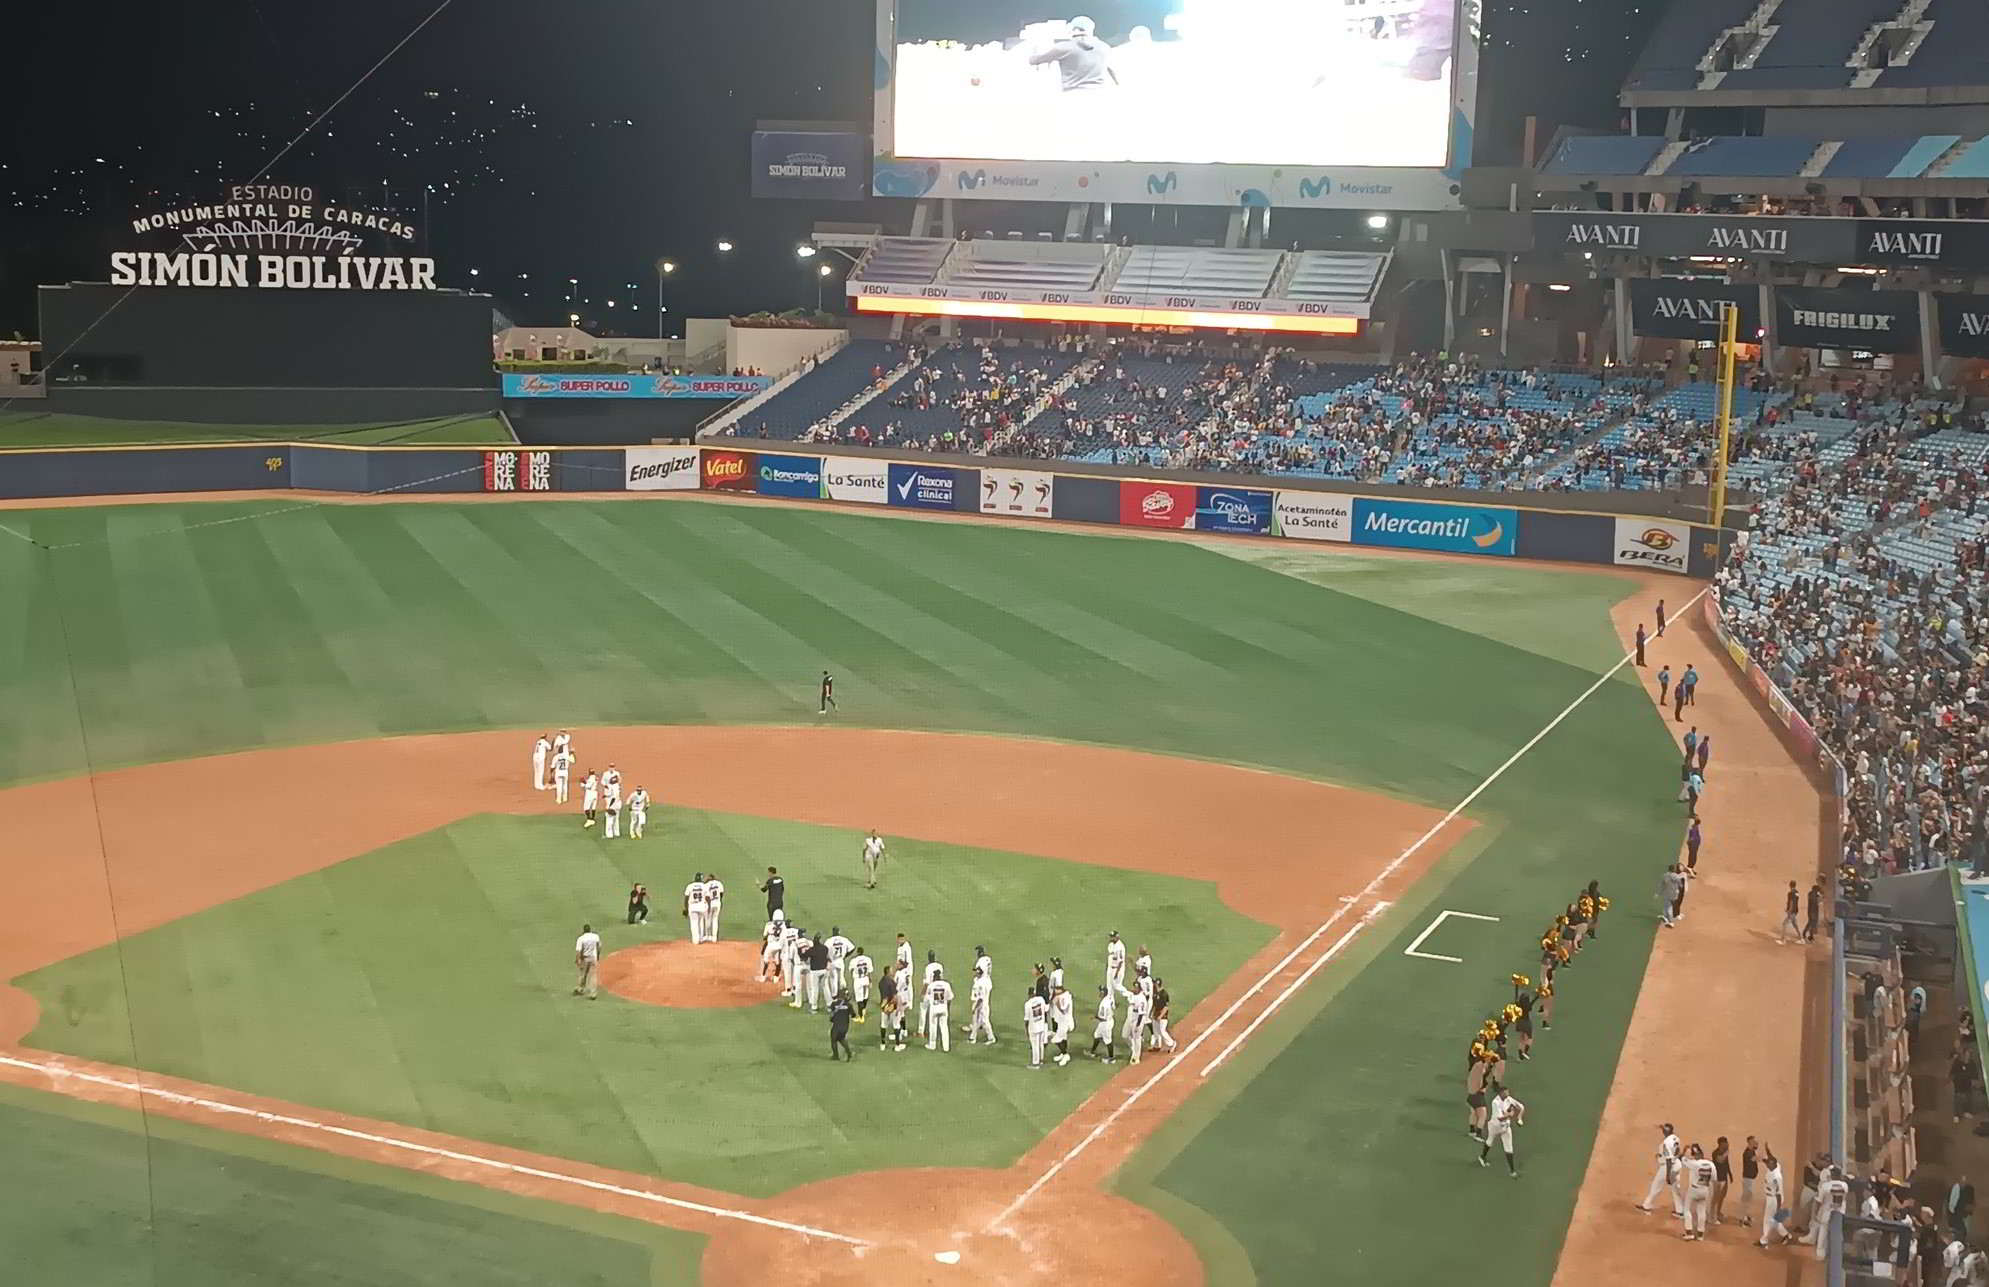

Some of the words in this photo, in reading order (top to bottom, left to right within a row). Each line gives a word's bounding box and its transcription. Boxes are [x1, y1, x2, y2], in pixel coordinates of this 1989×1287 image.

[801, 163, 846, 177] BOLÍVAR
[231, 185, 313, 201] ESTADIO
[1340, 183, 1393, 194] Movistar
[132, 203, 278, 234] MONUMENTAL
[287, 204, 313, 219] DE
[323, 207, 417, 240] CARACAS
[1565, 224, 1640, 245] AVANTI
[1706, 227, 1788, 249] AVANTI
[1868, 232, 1942, 254] AVANTI
[110, 243, 249, 287] SIMÓN
[257, 247, 437, 290] BOLÍVAR
[1793, 310, 1890, 330] FRIGILUX
[560, 381, 594, 392] SUPER
[596, 381, 629, 392] POLLO
[692, 382, 725, 393] SUPER
[630, 455, 697, 482] Energizer
[706, 458, 744, 476] Vatel
[828, 473, 843, 485] La
[847, 475, 885, 488] Santé
[917, 474, 953, 488] Rexona
[1217, 501, 1250, 514] ZONA
[1278, 504, 1347, 516] Acetaminofén
[1285, 515, 1300, 526] La
[1302, 516, 1339, 529] Santé
[1364, 511, 1470, 538] Mercantil
[1620, 550, 1684, 567] BERA
